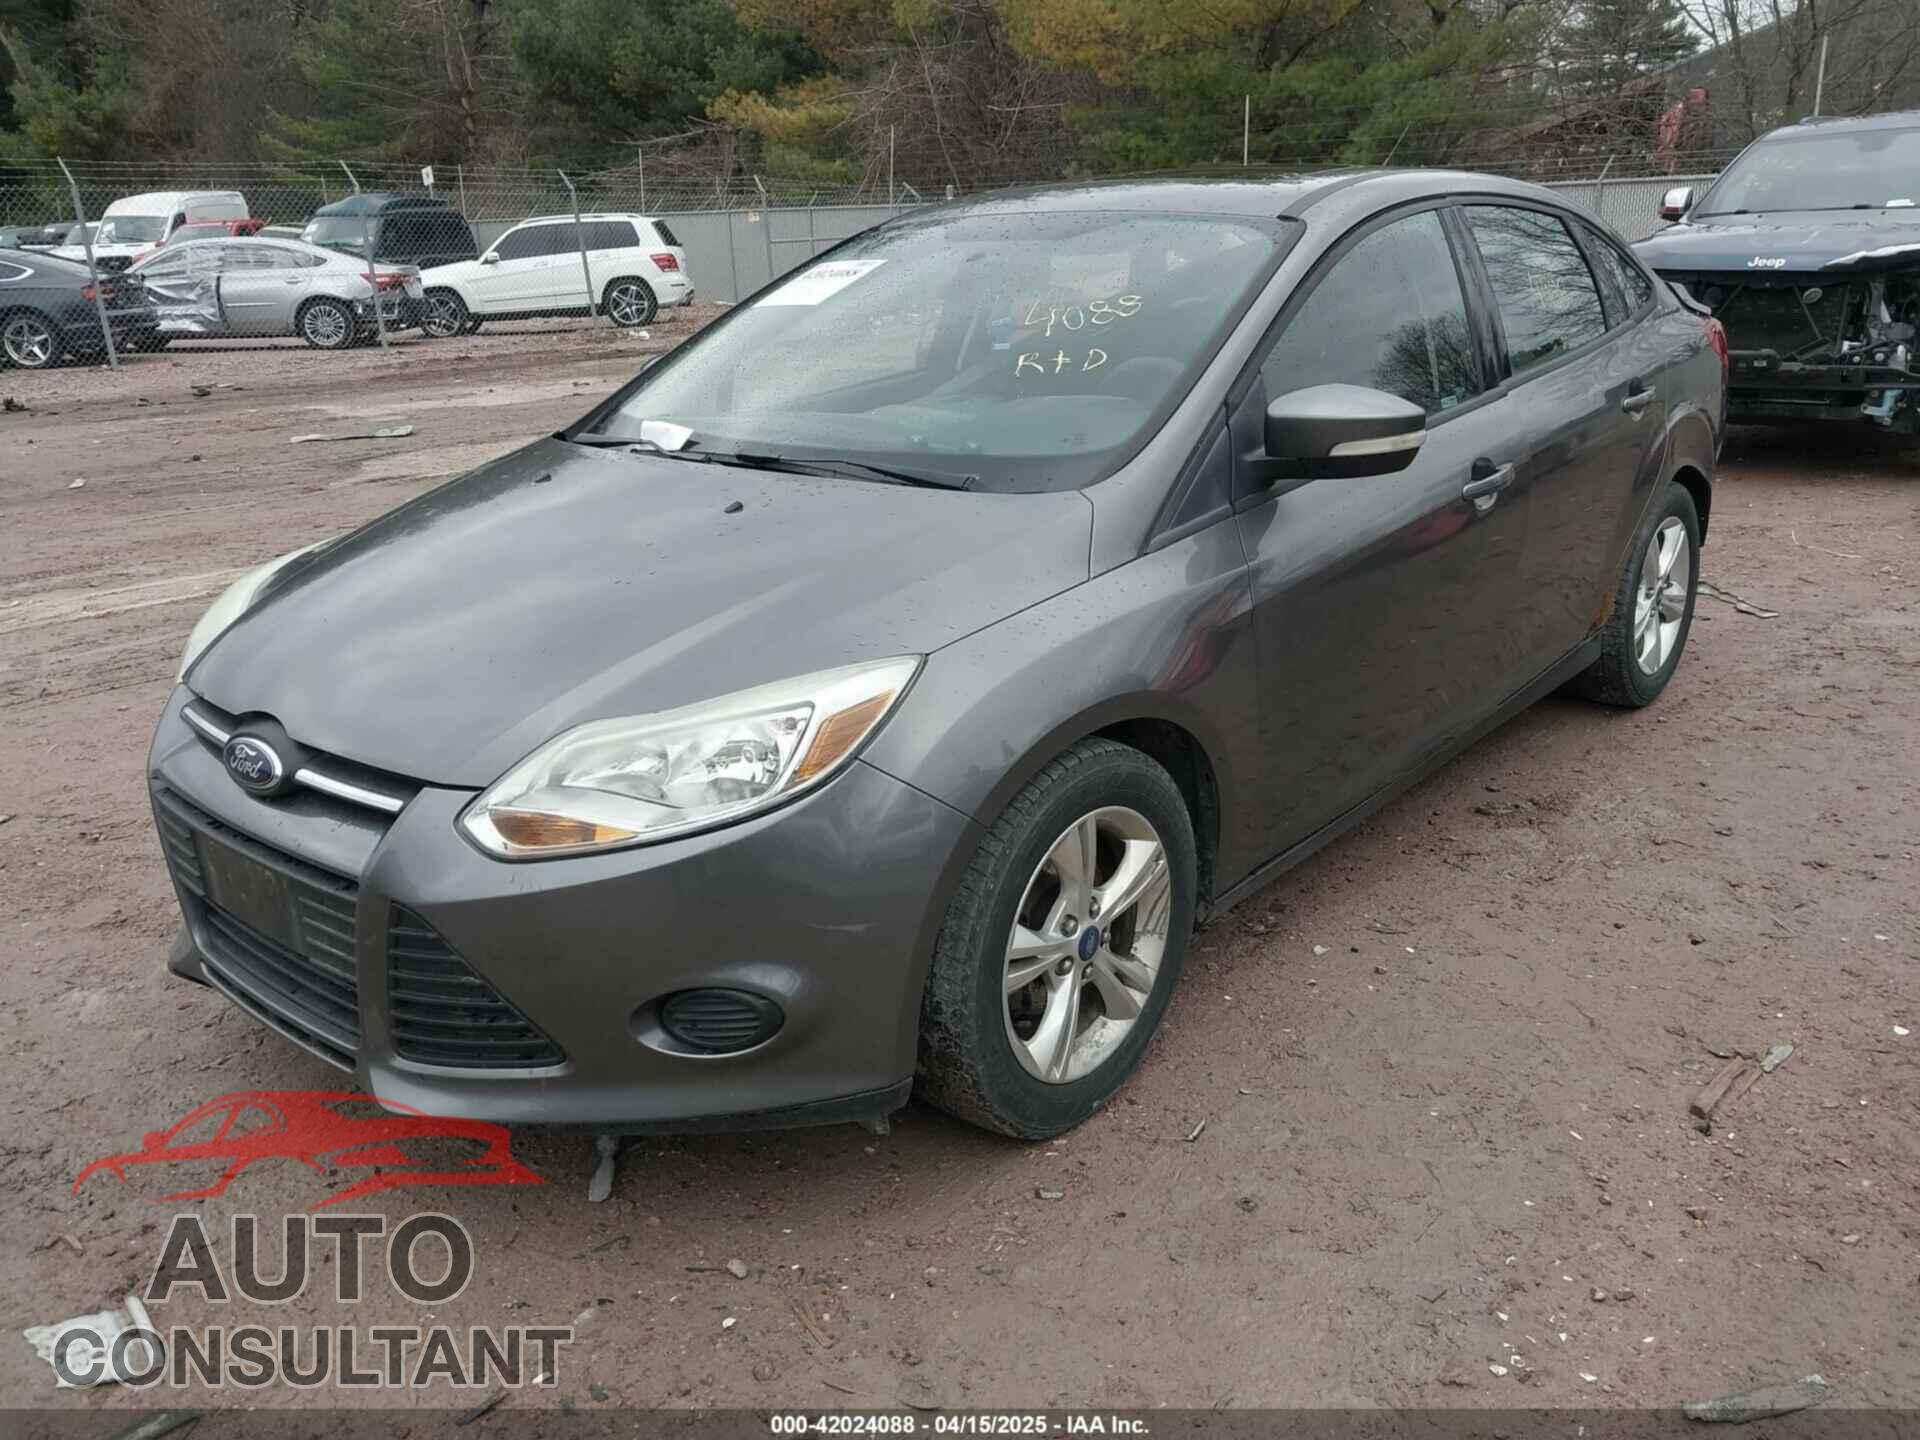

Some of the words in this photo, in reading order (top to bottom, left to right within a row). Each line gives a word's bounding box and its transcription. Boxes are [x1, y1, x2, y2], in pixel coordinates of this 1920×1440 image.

[1747, 256, 1786, 269] Jeep
[1024, 295, 1144, 337] 4088
[229, 744, 264, 779] Ford
